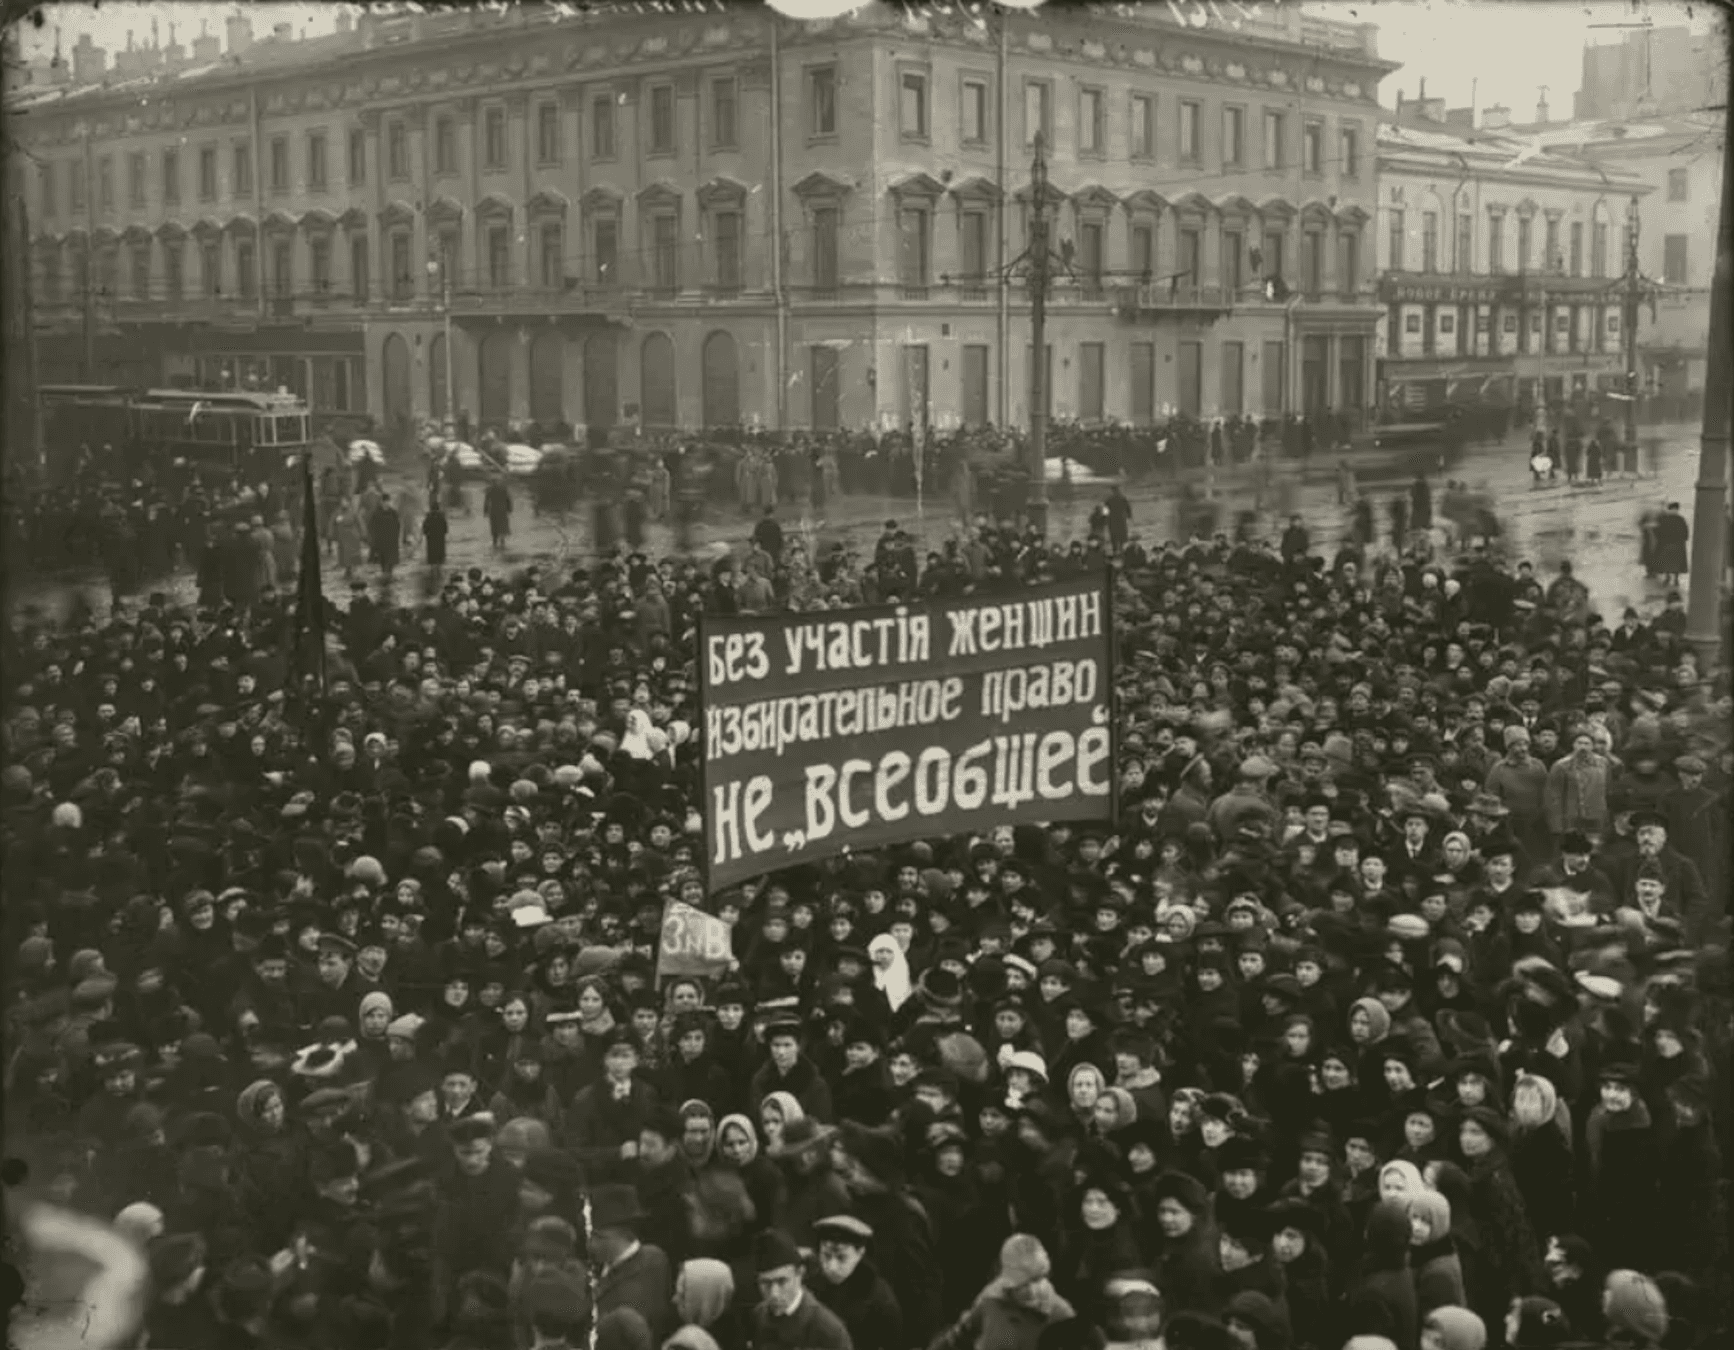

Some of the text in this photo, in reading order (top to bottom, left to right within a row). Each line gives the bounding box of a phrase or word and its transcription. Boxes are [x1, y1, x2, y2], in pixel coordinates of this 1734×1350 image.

[784, 606, 931, 675] участія
[946, 590, 1103, 657] женщин
[705, 658, 1098, 761] избирательное право
